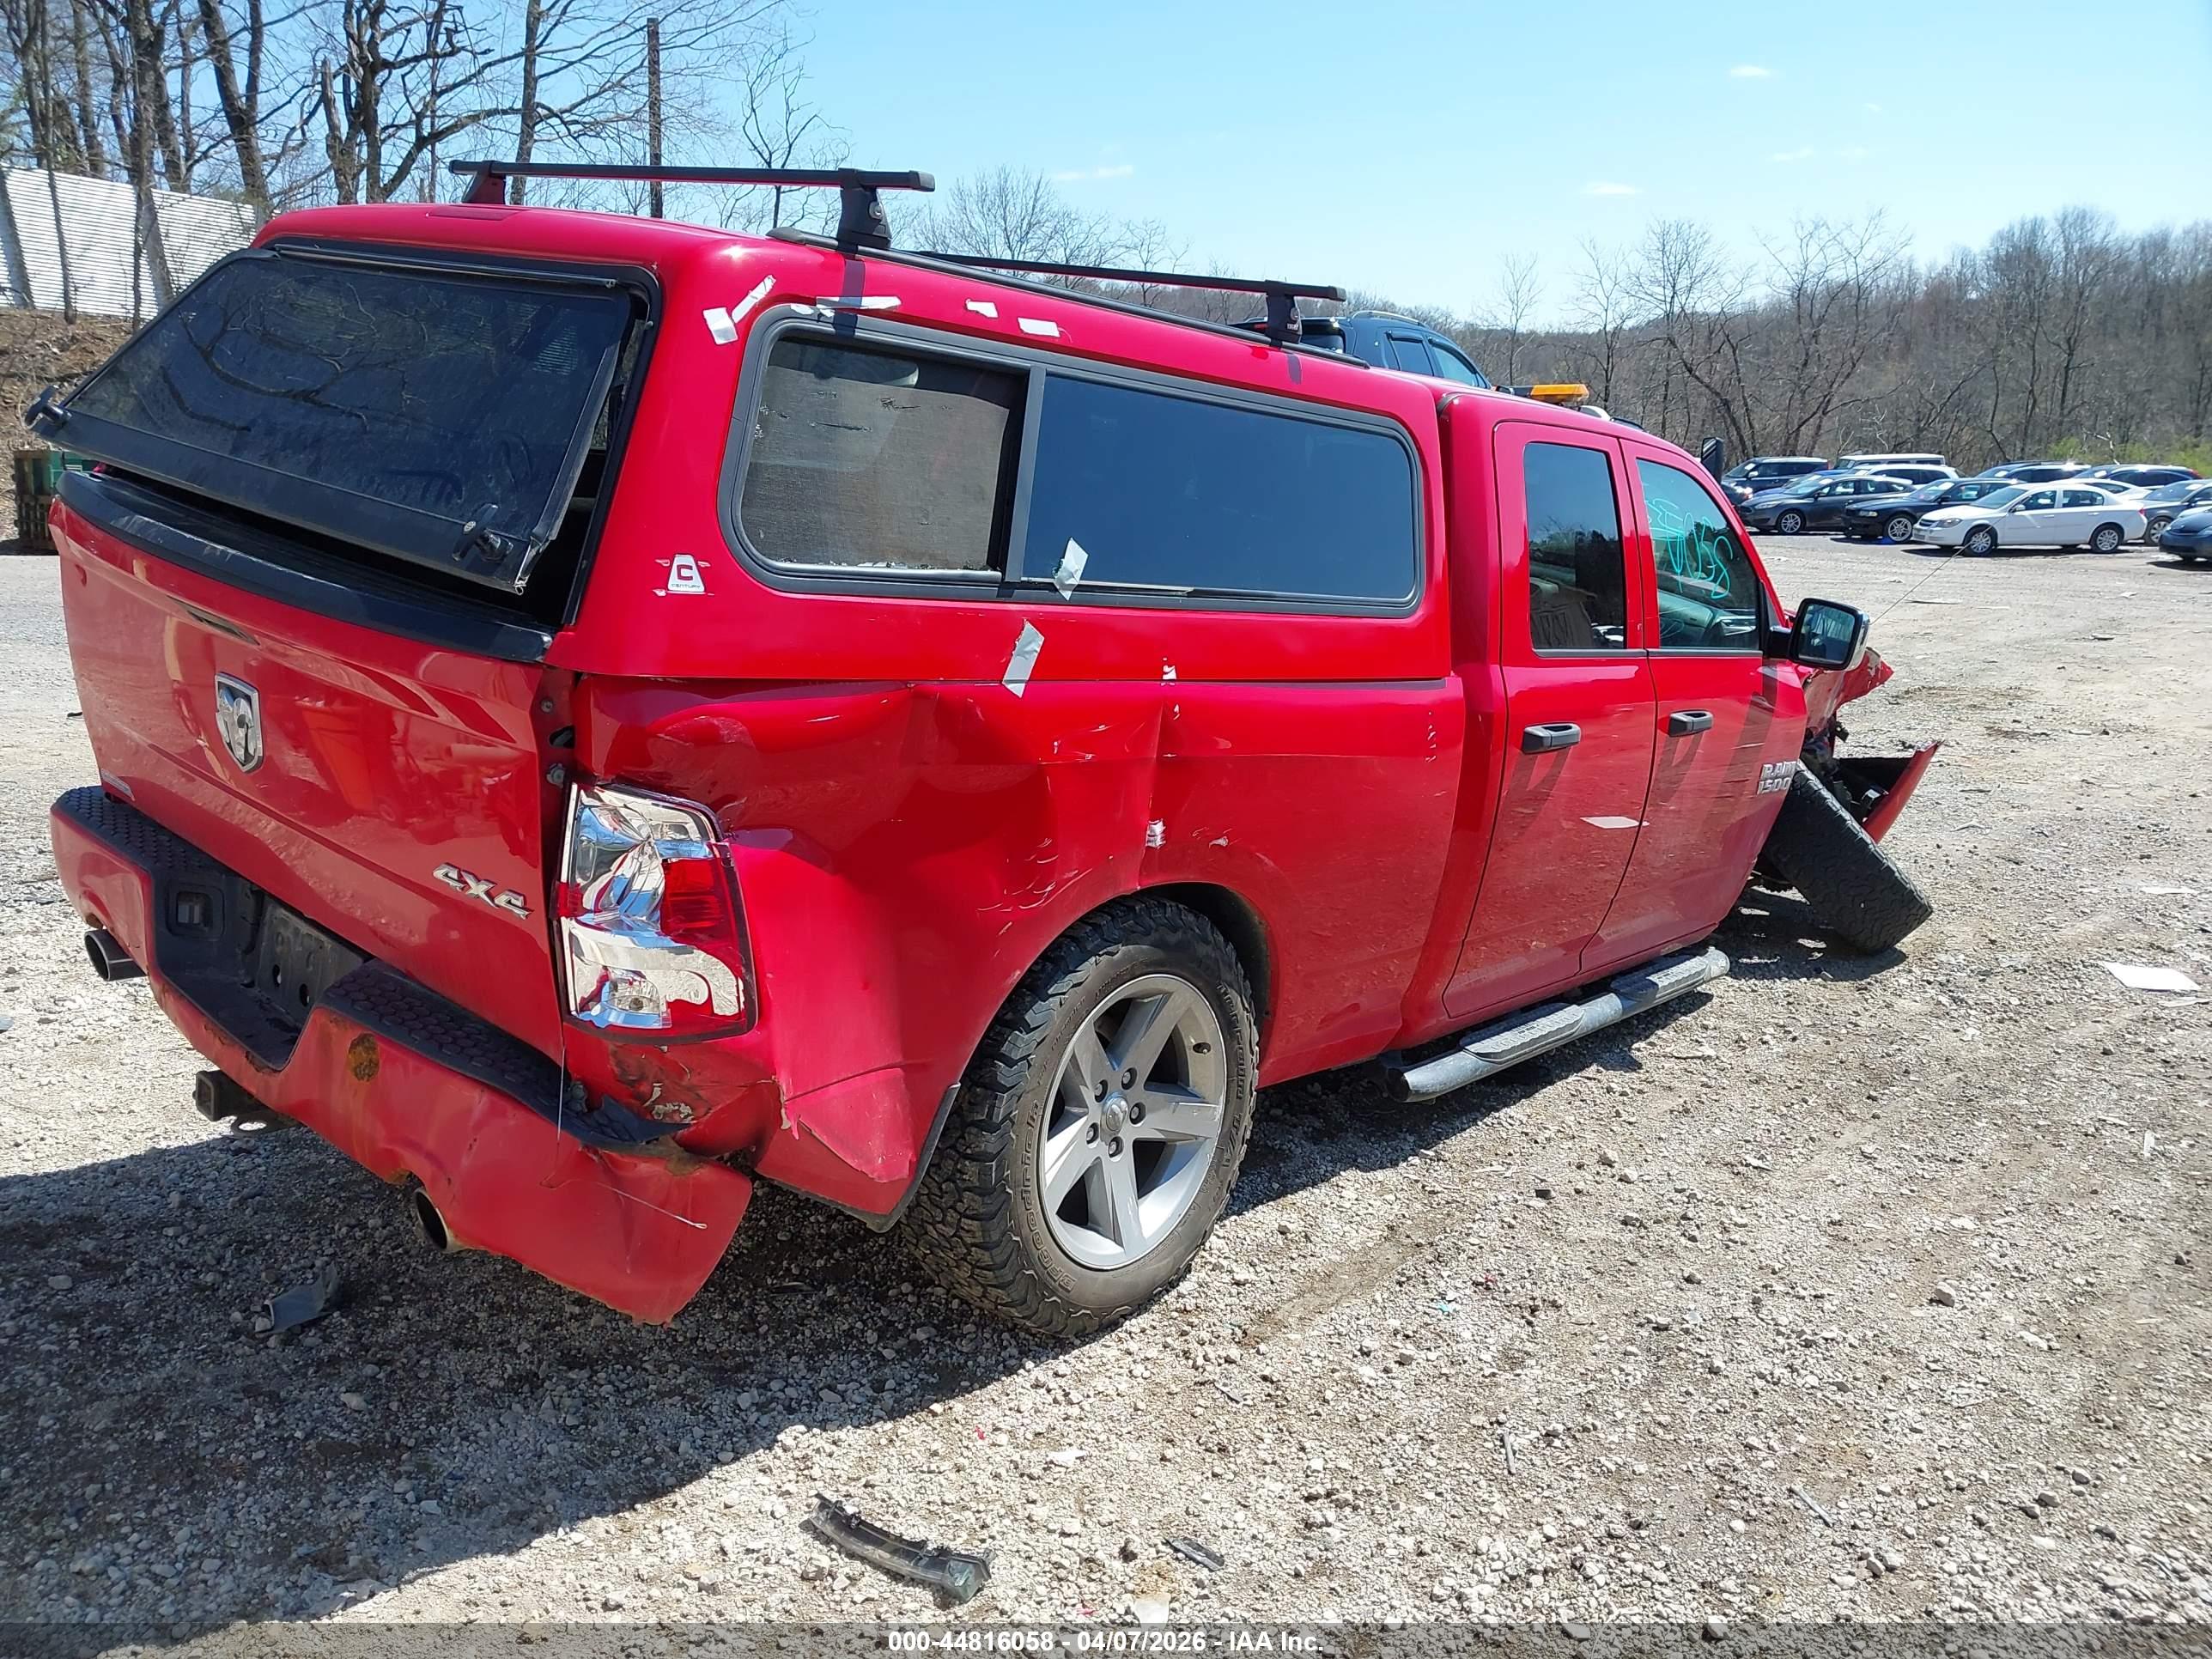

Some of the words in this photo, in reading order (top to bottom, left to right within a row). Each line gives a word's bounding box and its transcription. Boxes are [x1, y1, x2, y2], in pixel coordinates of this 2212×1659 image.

[677, 564, 693, 580] C
[1761, 761, 1796, 780] RAM
[1757, 777, 1793, 795] 1500
